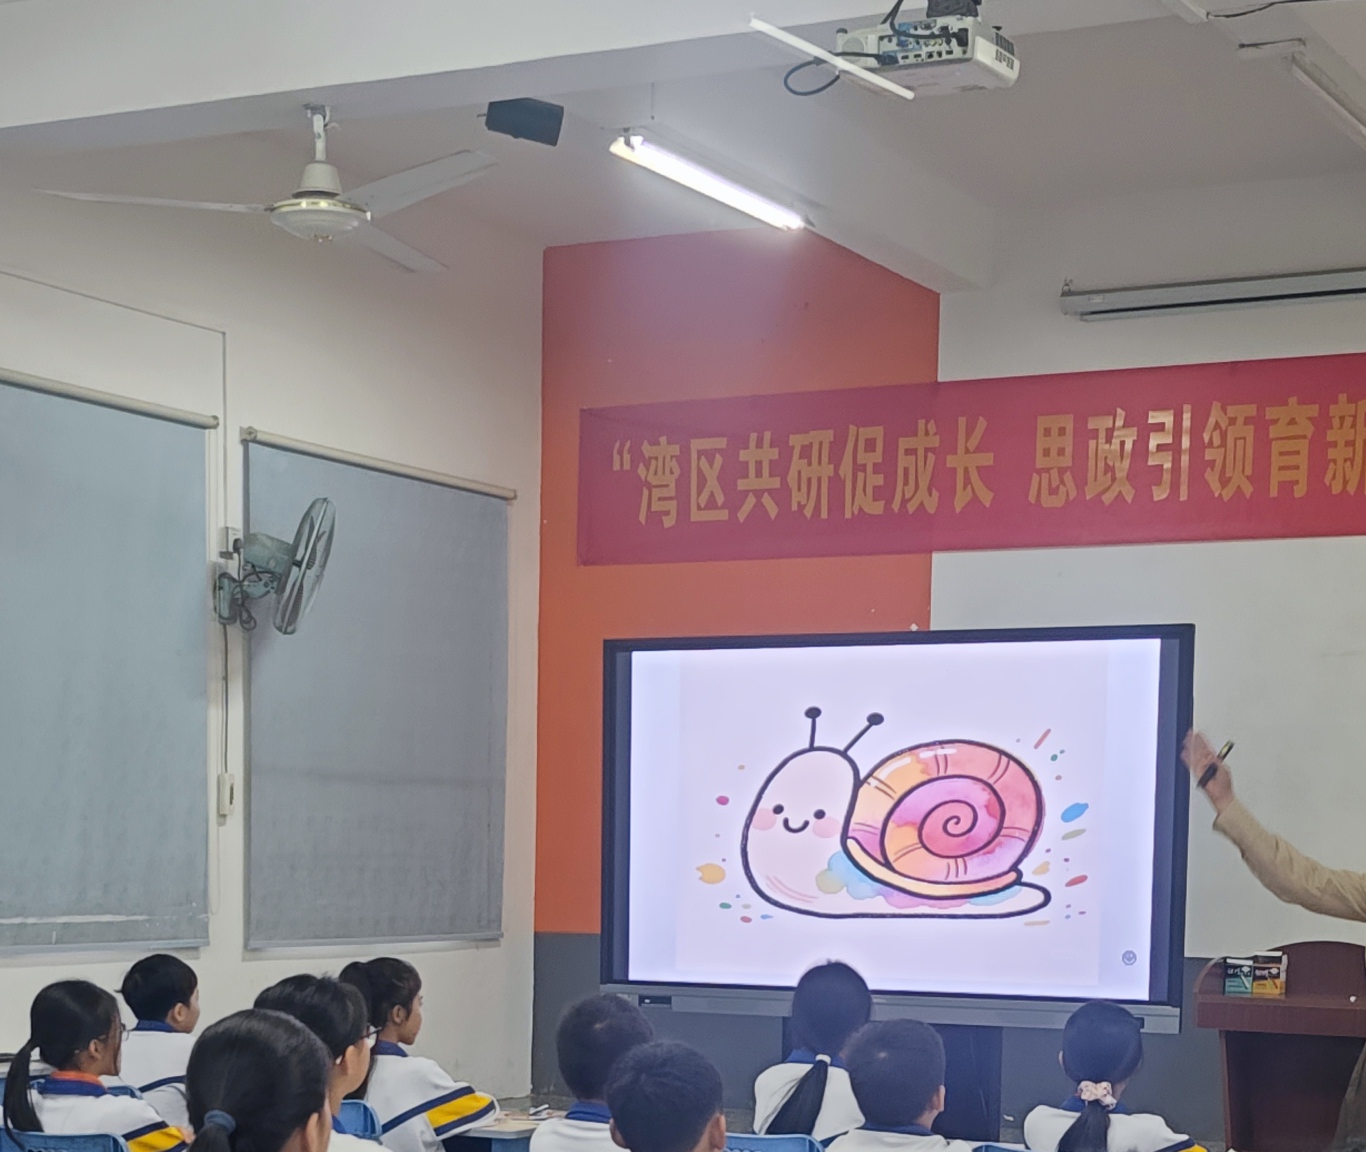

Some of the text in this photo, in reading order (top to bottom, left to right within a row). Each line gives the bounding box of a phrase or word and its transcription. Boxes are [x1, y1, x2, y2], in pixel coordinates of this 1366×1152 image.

[612, 415, 995, 528] “湾区共研促成长
